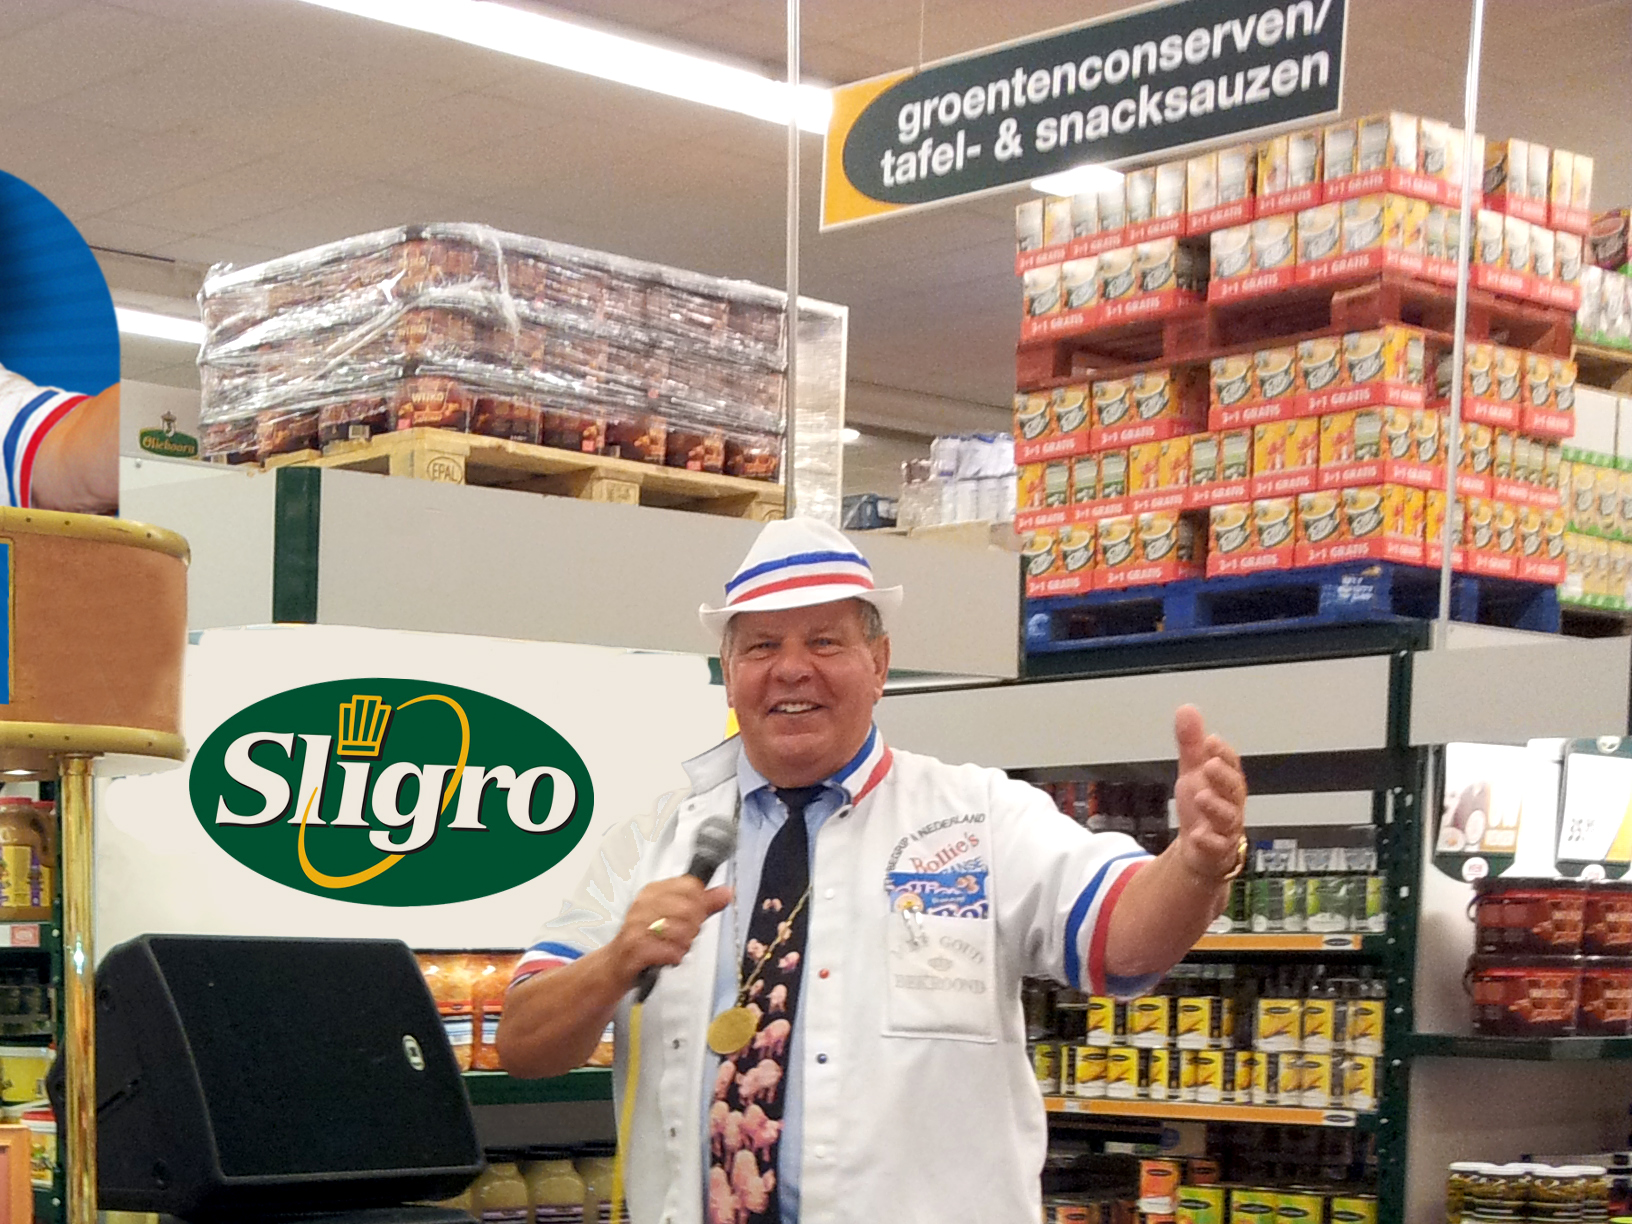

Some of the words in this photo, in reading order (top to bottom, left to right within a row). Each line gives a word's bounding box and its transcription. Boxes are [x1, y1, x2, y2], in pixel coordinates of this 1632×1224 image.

[881, 136, 982, 188] tafel-
[994, 117, 1023, 162] &
[1034, 49, 1331, 152] snacksauzen
[898, 0, 1332, 145] groentenconserven/
[431, 462, 460, 483] EPAL
[215, 730, 579, 855] Sligro
[918, 813, 986, 838] NEDERLAND
